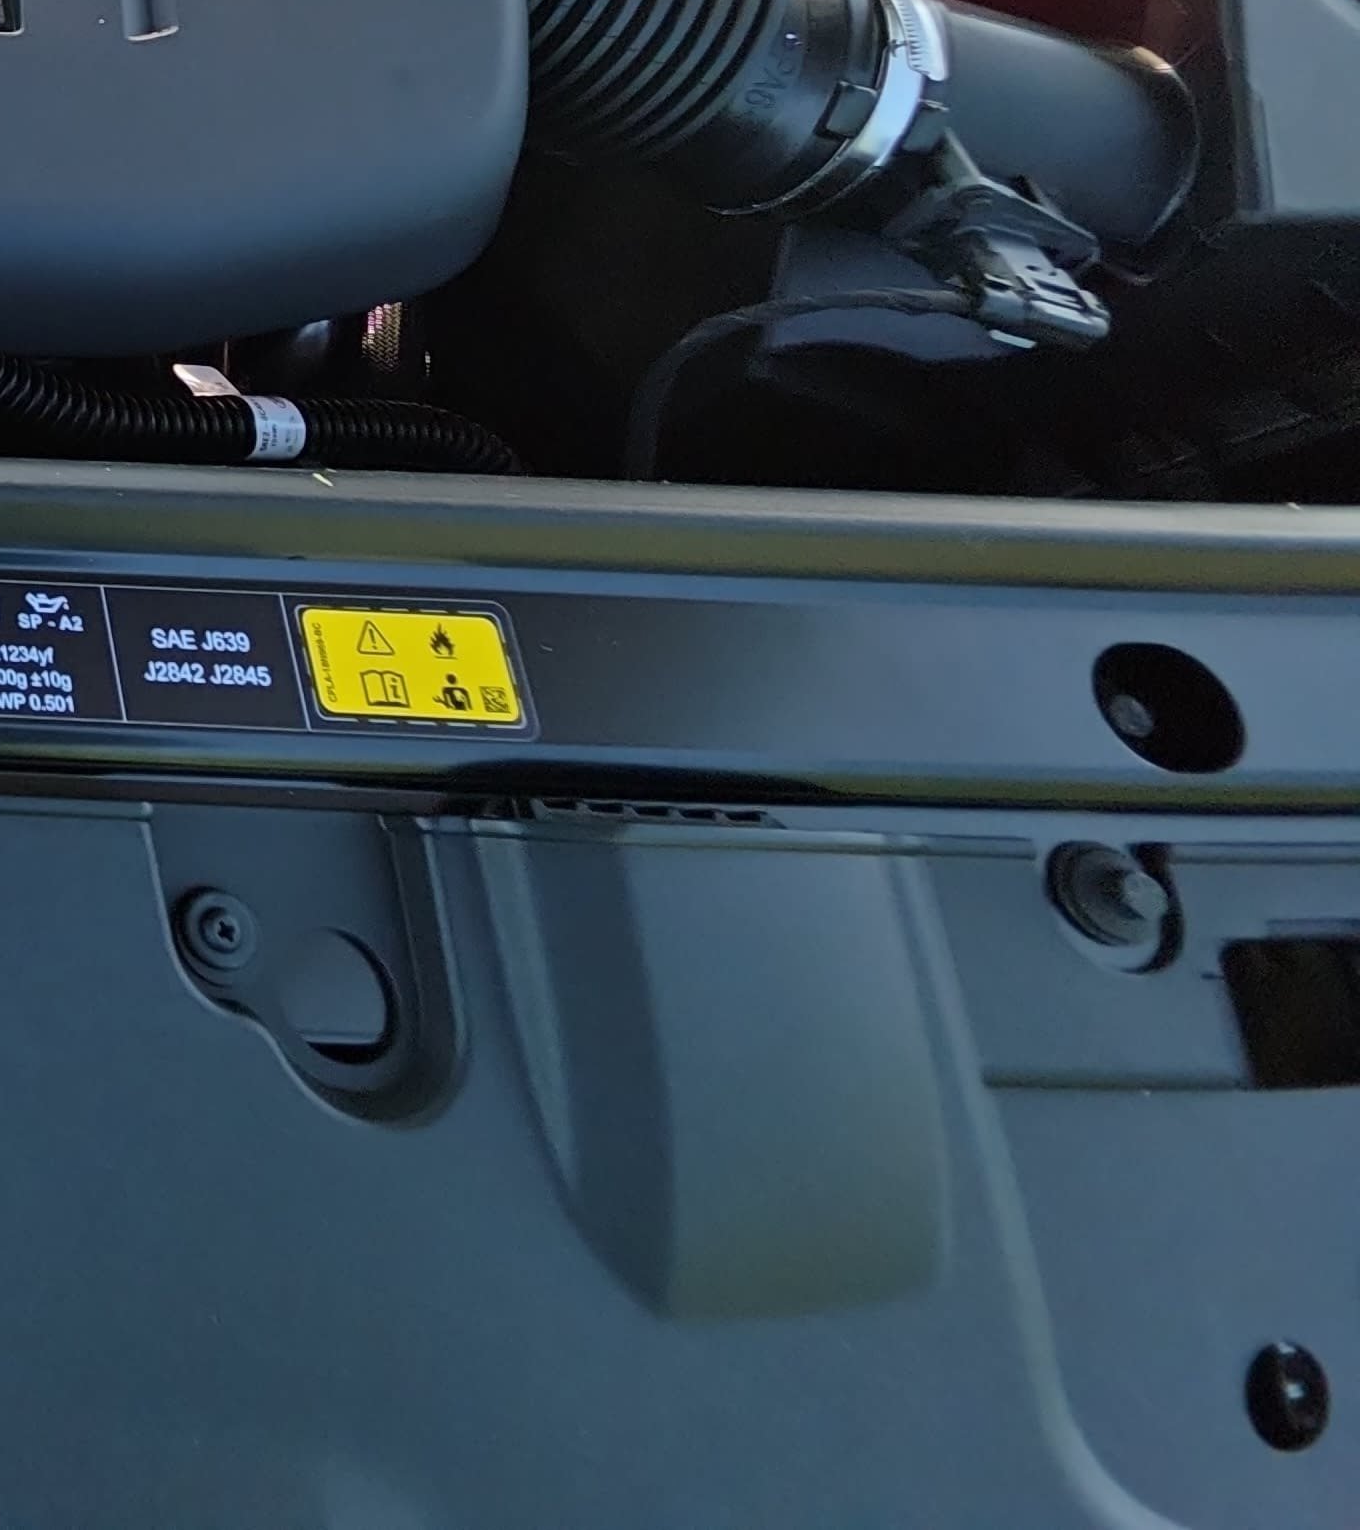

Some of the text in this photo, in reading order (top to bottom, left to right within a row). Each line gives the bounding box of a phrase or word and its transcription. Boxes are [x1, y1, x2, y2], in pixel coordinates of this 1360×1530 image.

[17, 613, 43, 629] SP
[58, 615, 84, 632] A2
[150, 627, 251, 653] SAE J639
[30, 671, 73, 692] ±10g
[143, 660, 272, 687] J2842 J2845
[29, 693, 75, 713] 0.501
